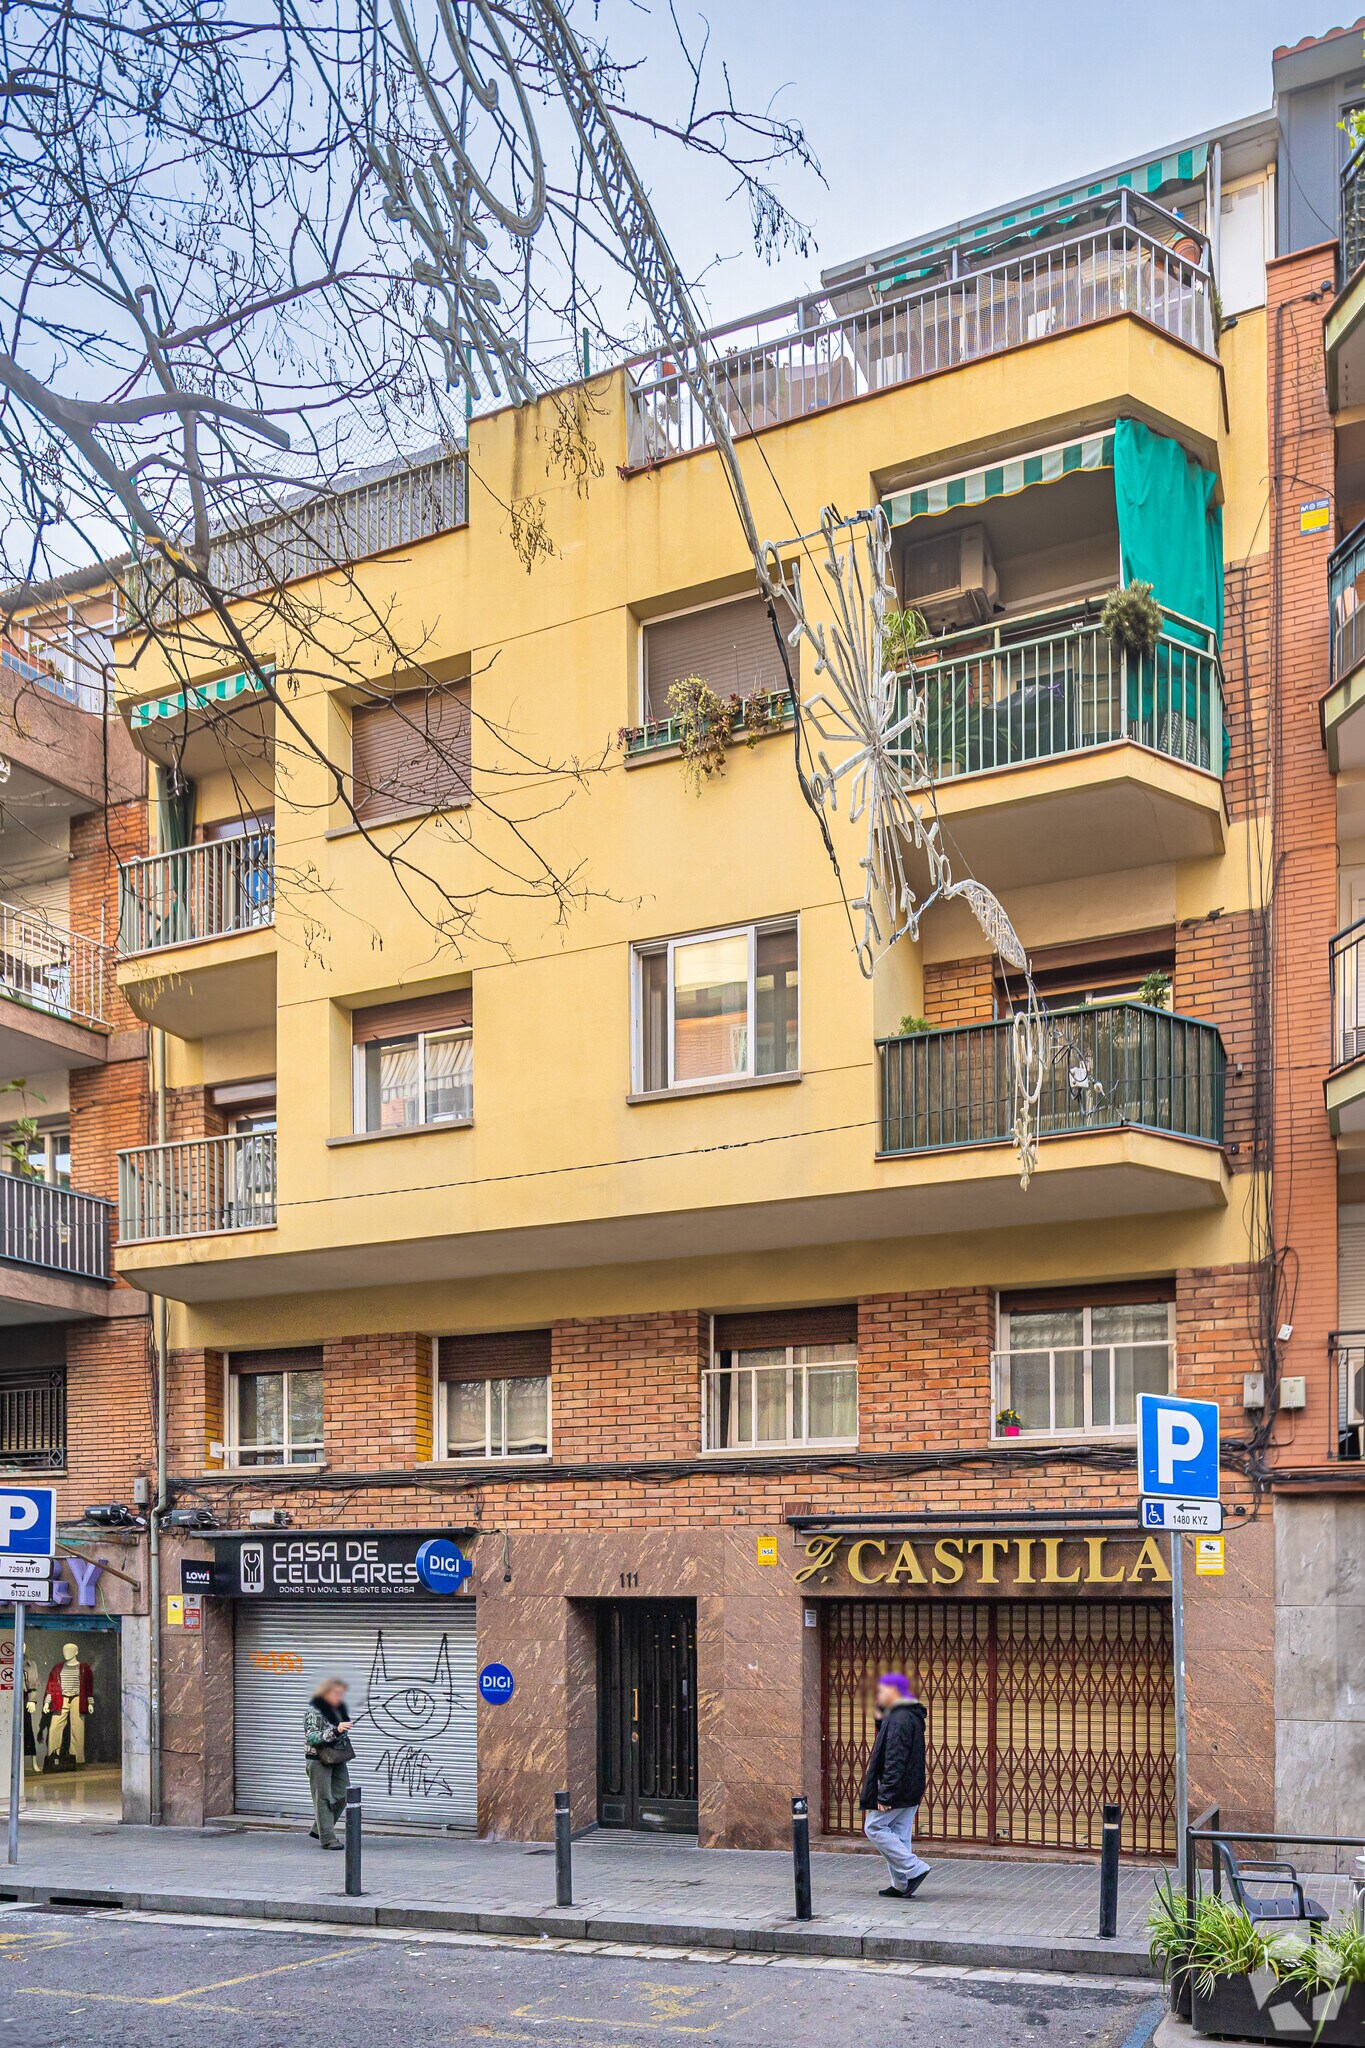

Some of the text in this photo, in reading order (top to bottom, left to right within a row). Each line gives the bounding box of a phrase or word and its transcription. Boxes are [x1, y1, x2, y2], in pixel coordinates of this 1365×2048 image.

[1157, 1408, 1204, 1485] P
[0, 1494, 39, 1547] P
[1173, 1515, 1208, 1526] 1480 KYZ
[272, 1541, 379, 1562] CASA DE
[847, 1536, 1173, 1584] CASTILLA
[8, 1565, 41, 1574] 7299 MYB
[429, 1555, 459, 1573] DIGI
[273, 1563, 420, 1584] CELULARES
[619, 1572, 638, 1588] 111
[11, 1589, 41, 1598] 6132 LSM
[393, 1586, 415, 1594] CASA
[482, 1675, 511, 1688] DIGI
